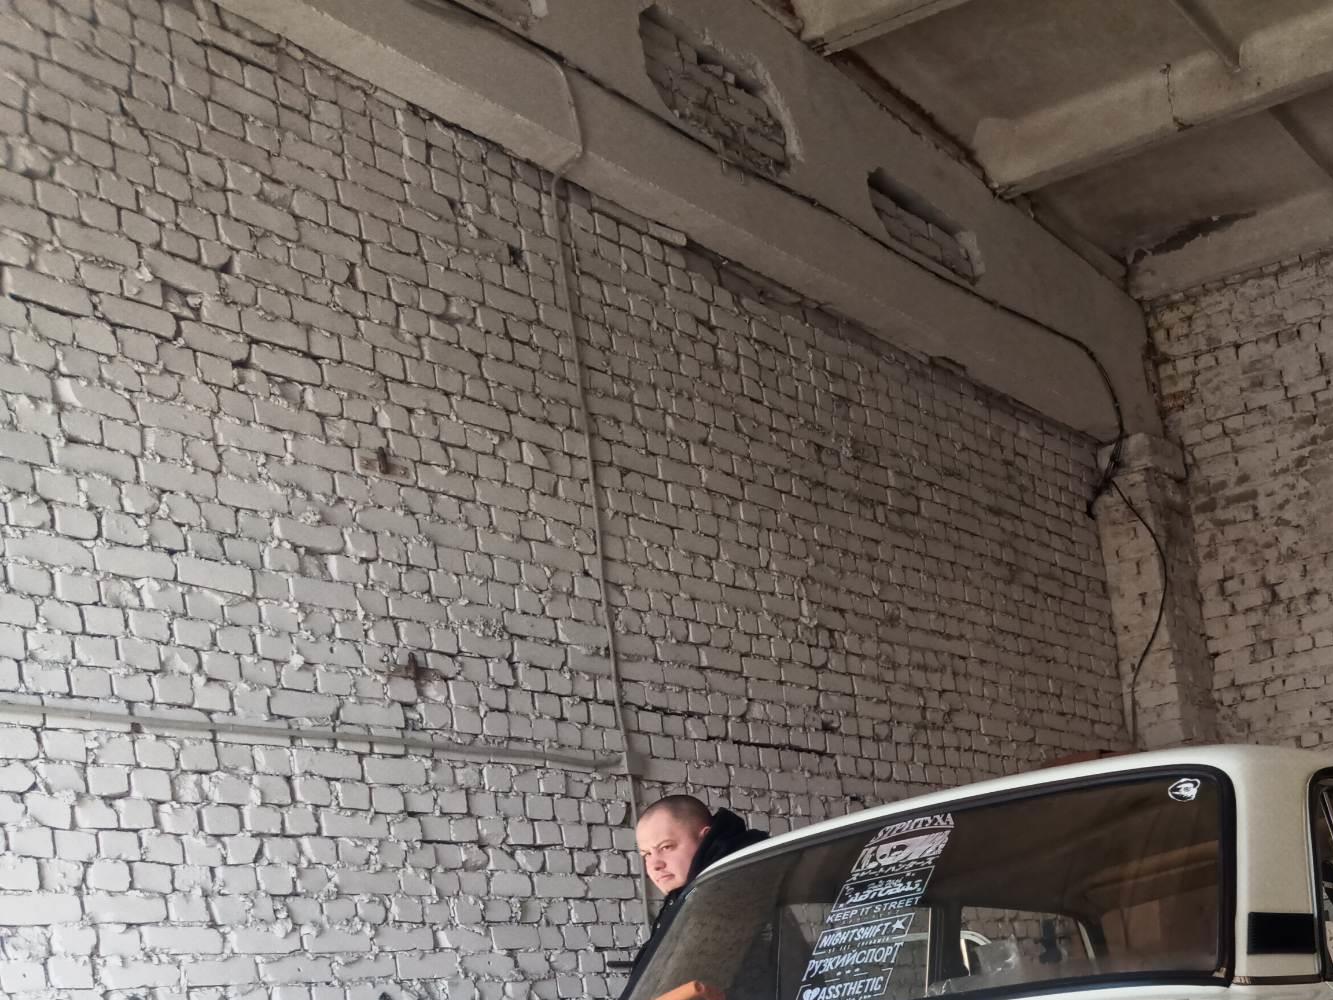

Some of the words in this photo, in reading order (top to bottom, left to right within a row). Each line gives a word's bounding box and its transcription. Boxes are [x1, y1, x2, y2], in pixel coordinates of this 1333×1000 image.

[826, 910, 858, 924] KEEP
[859, 905, 870, 916] IT
[873, 896, 922, 913] STREET
[819, 922, 893, 948] NIGHTSHIFT
[801, 941, 905, 982] РУЗКИЙСПОРТ
